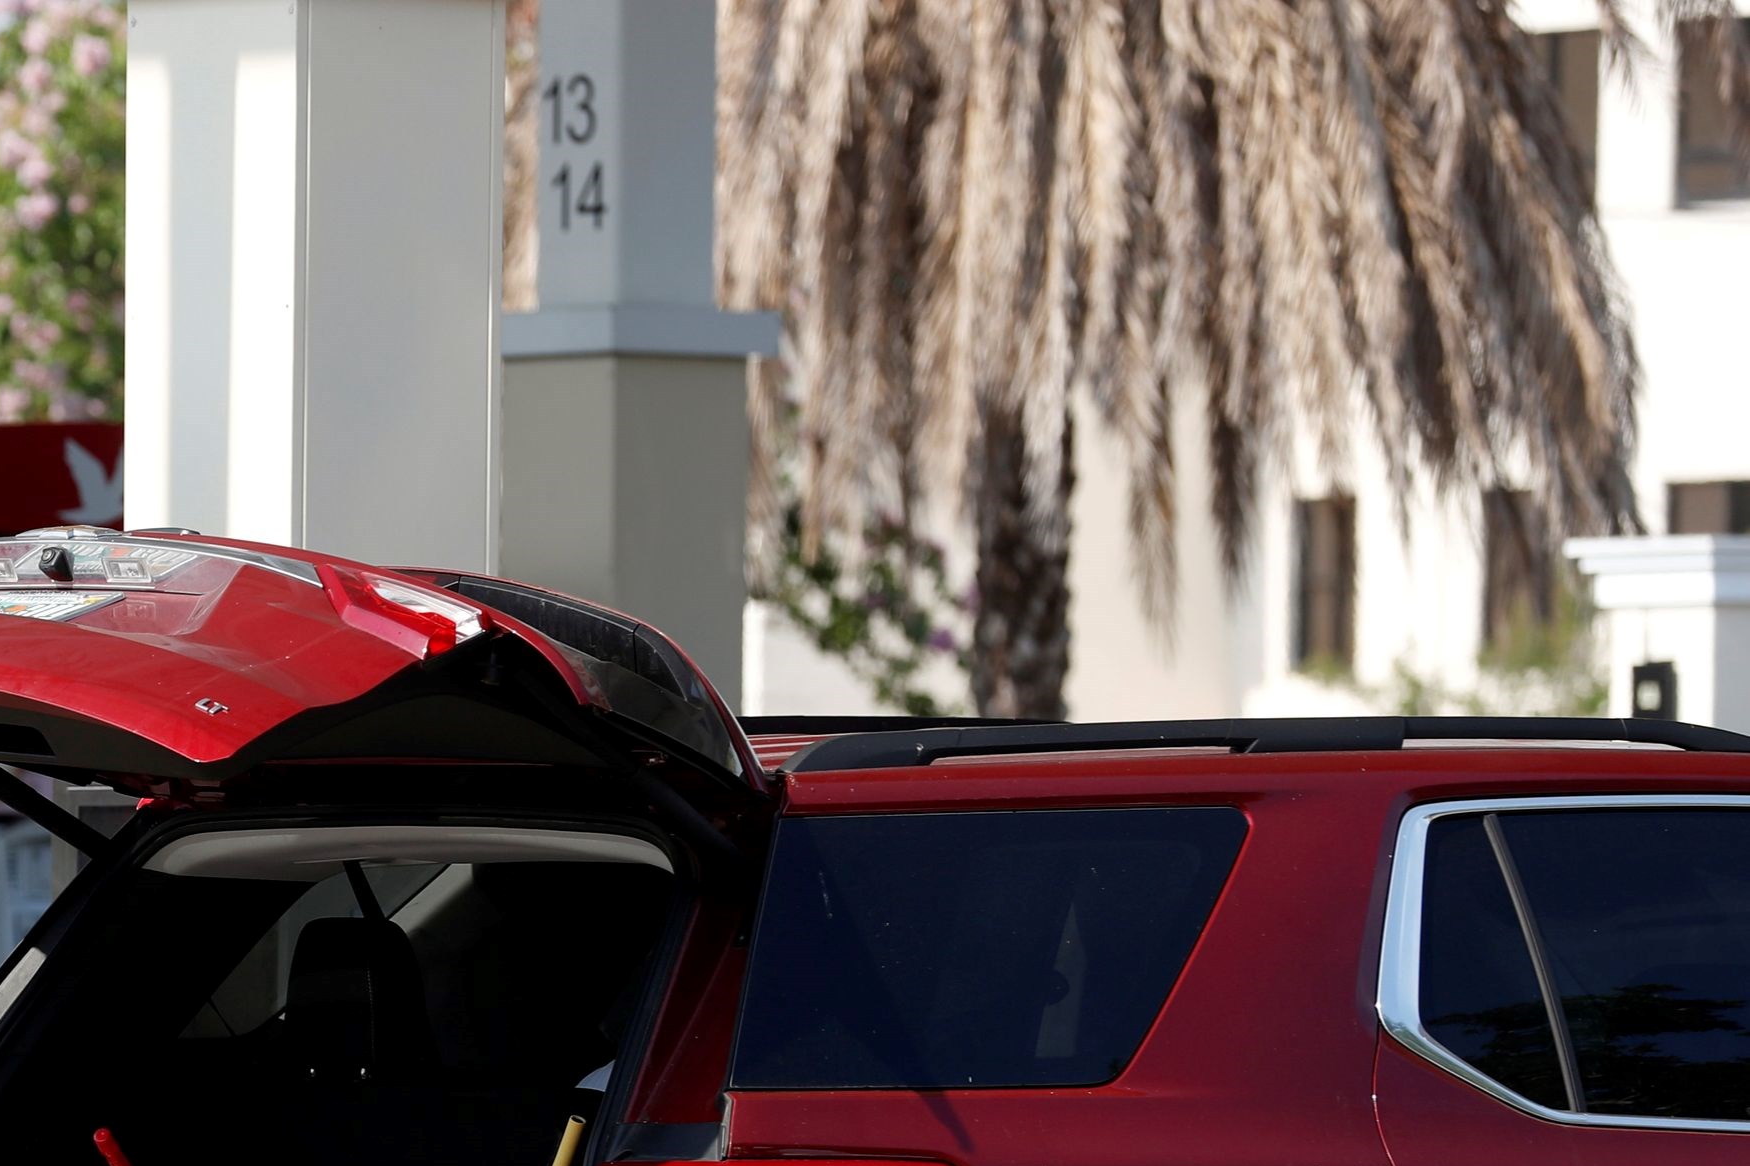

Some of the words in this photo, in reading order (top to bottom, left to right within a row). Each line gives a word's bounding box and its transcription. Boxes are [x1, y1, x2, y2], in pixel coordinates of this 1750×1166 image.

[543, 74, 597, 144] 13
[552, 161, 608, 231] 14
[194, 698, 229, 716] LT
